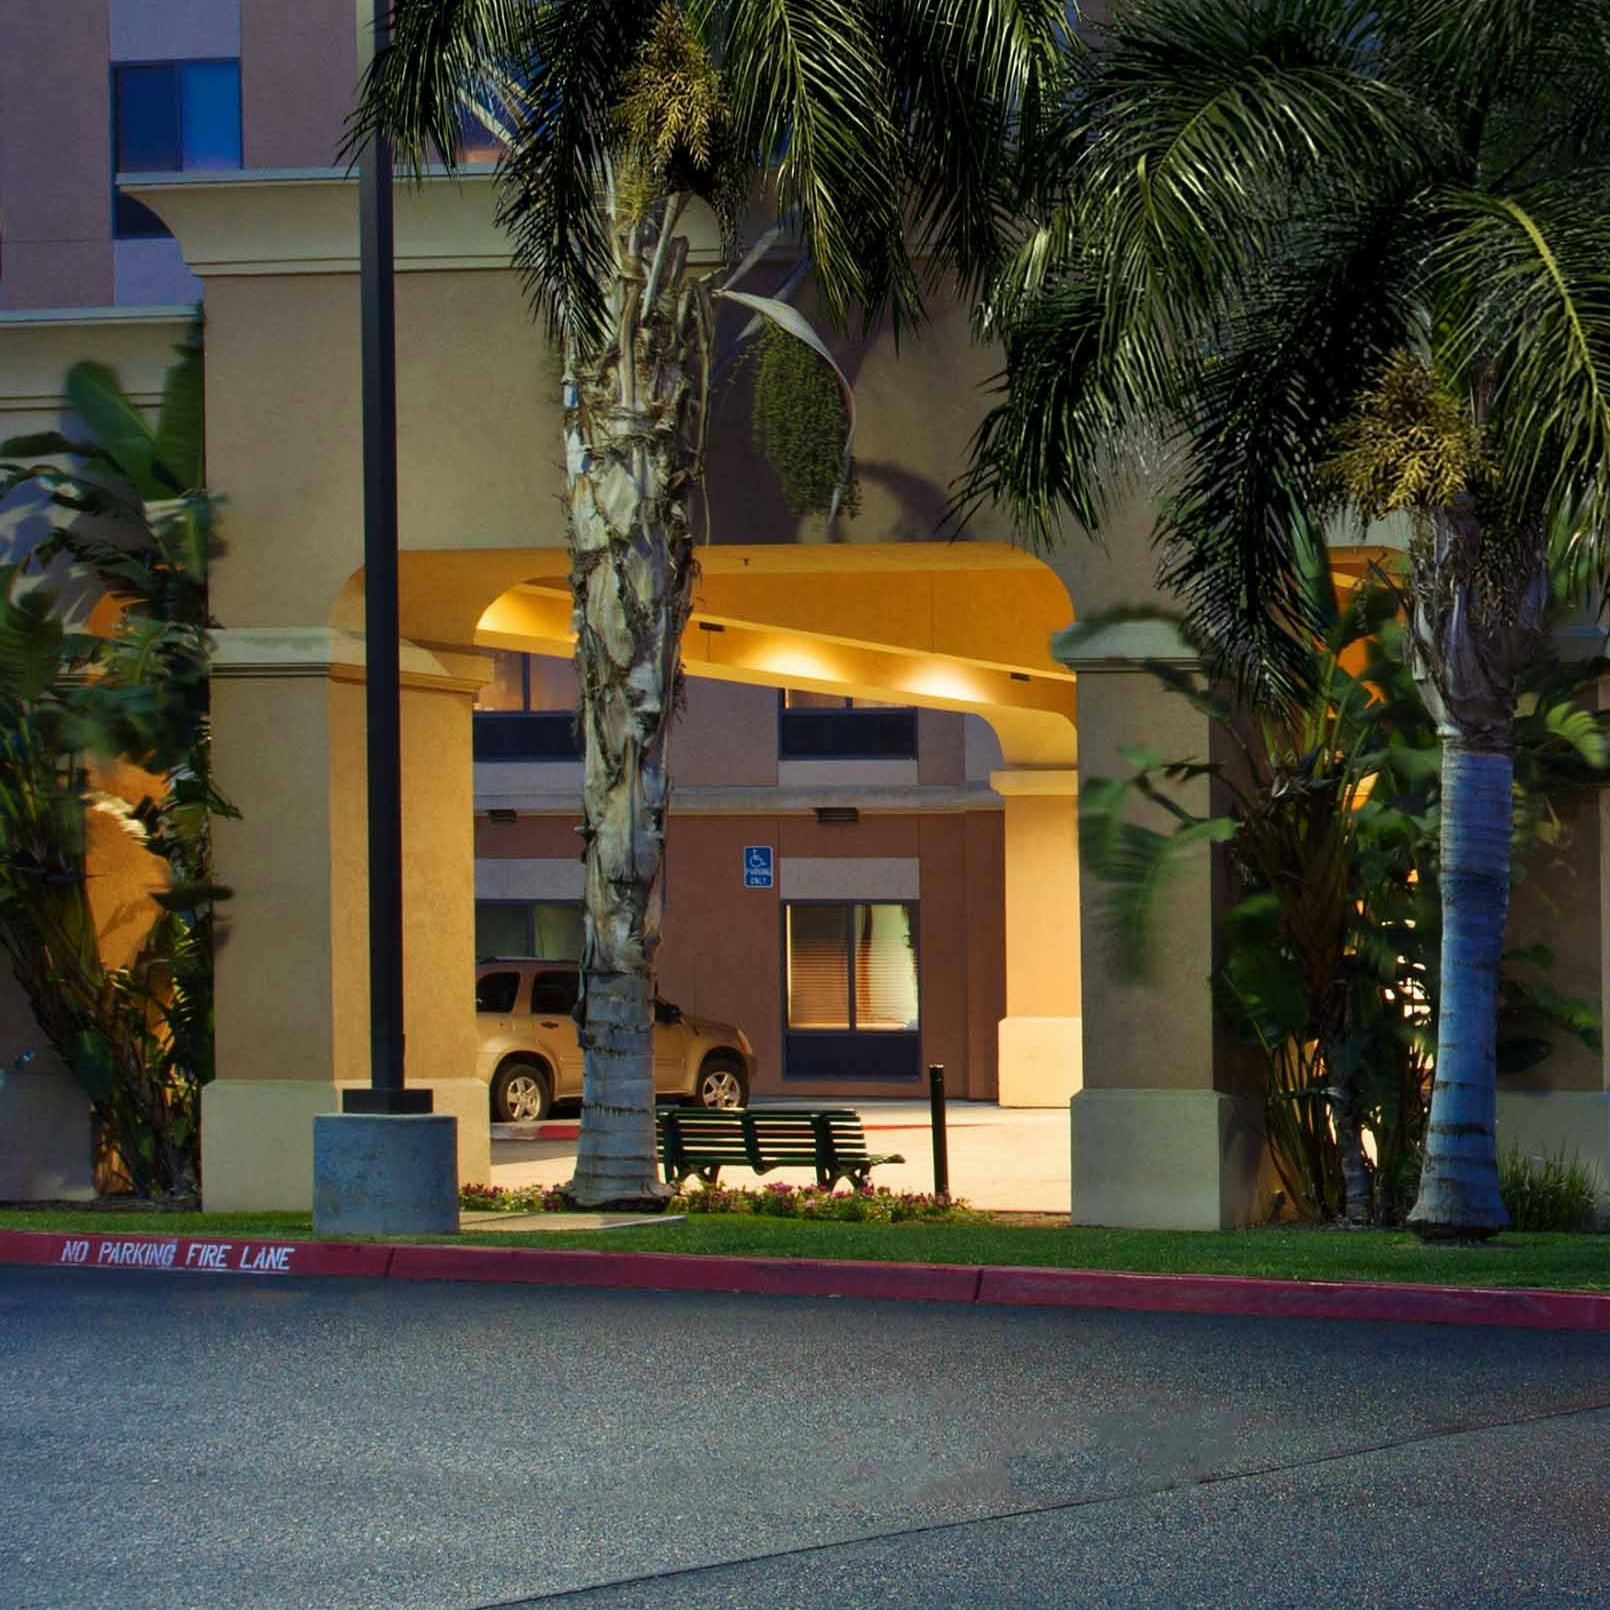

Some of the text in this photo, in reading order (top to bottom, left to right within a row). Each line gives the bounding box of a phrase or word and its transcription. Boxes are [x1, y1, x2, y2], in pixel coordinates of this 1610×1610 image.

[60, 1240, 296, 1271] NO PARKING FIRE LANE
